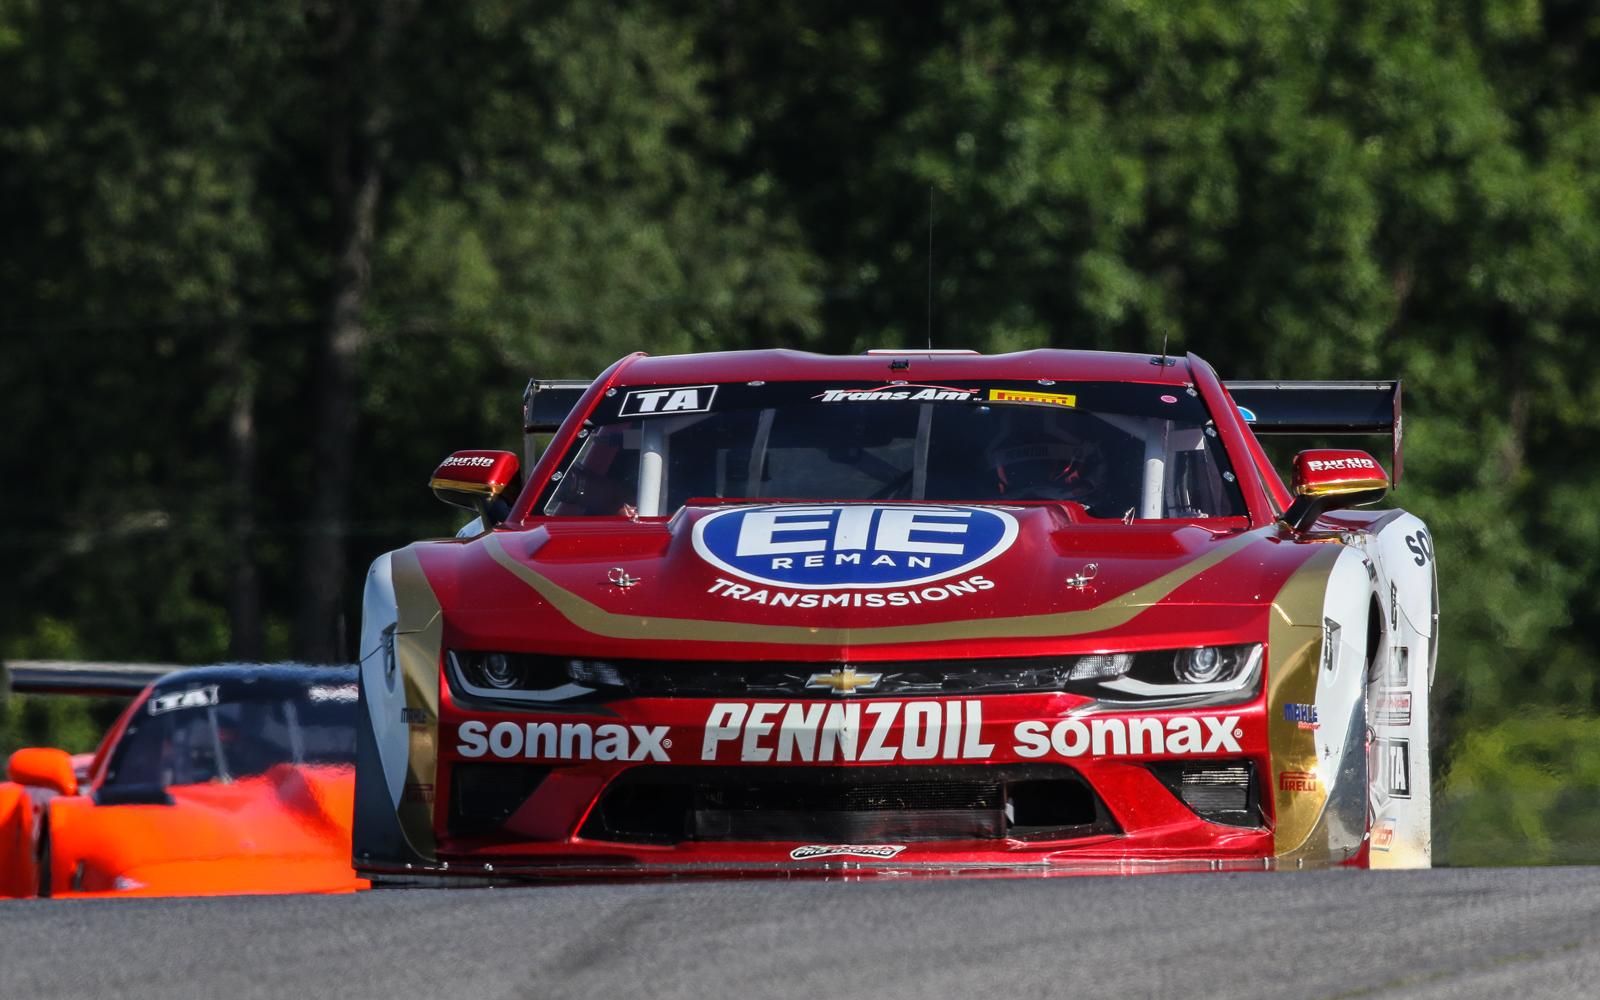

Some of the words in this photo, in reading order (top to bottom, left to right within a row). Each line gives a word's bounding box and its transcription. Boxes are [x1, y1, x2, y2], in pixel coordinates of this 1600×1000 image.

[637, 389, 699, 413] TA
[821, 389, 908, 402] Trans
[909, 389, 971, 401] Am
[735, 505, 972, 557] EIE
[771, 553, 931, 570] REMAN
[706, 574, 996, 609] TRANSMISSIONS
[701, 700, 996, 762] PENNZOIL
[1279, 772, 1317, 791] PIRELLI
[1389, 746, 1407, 790] TA
